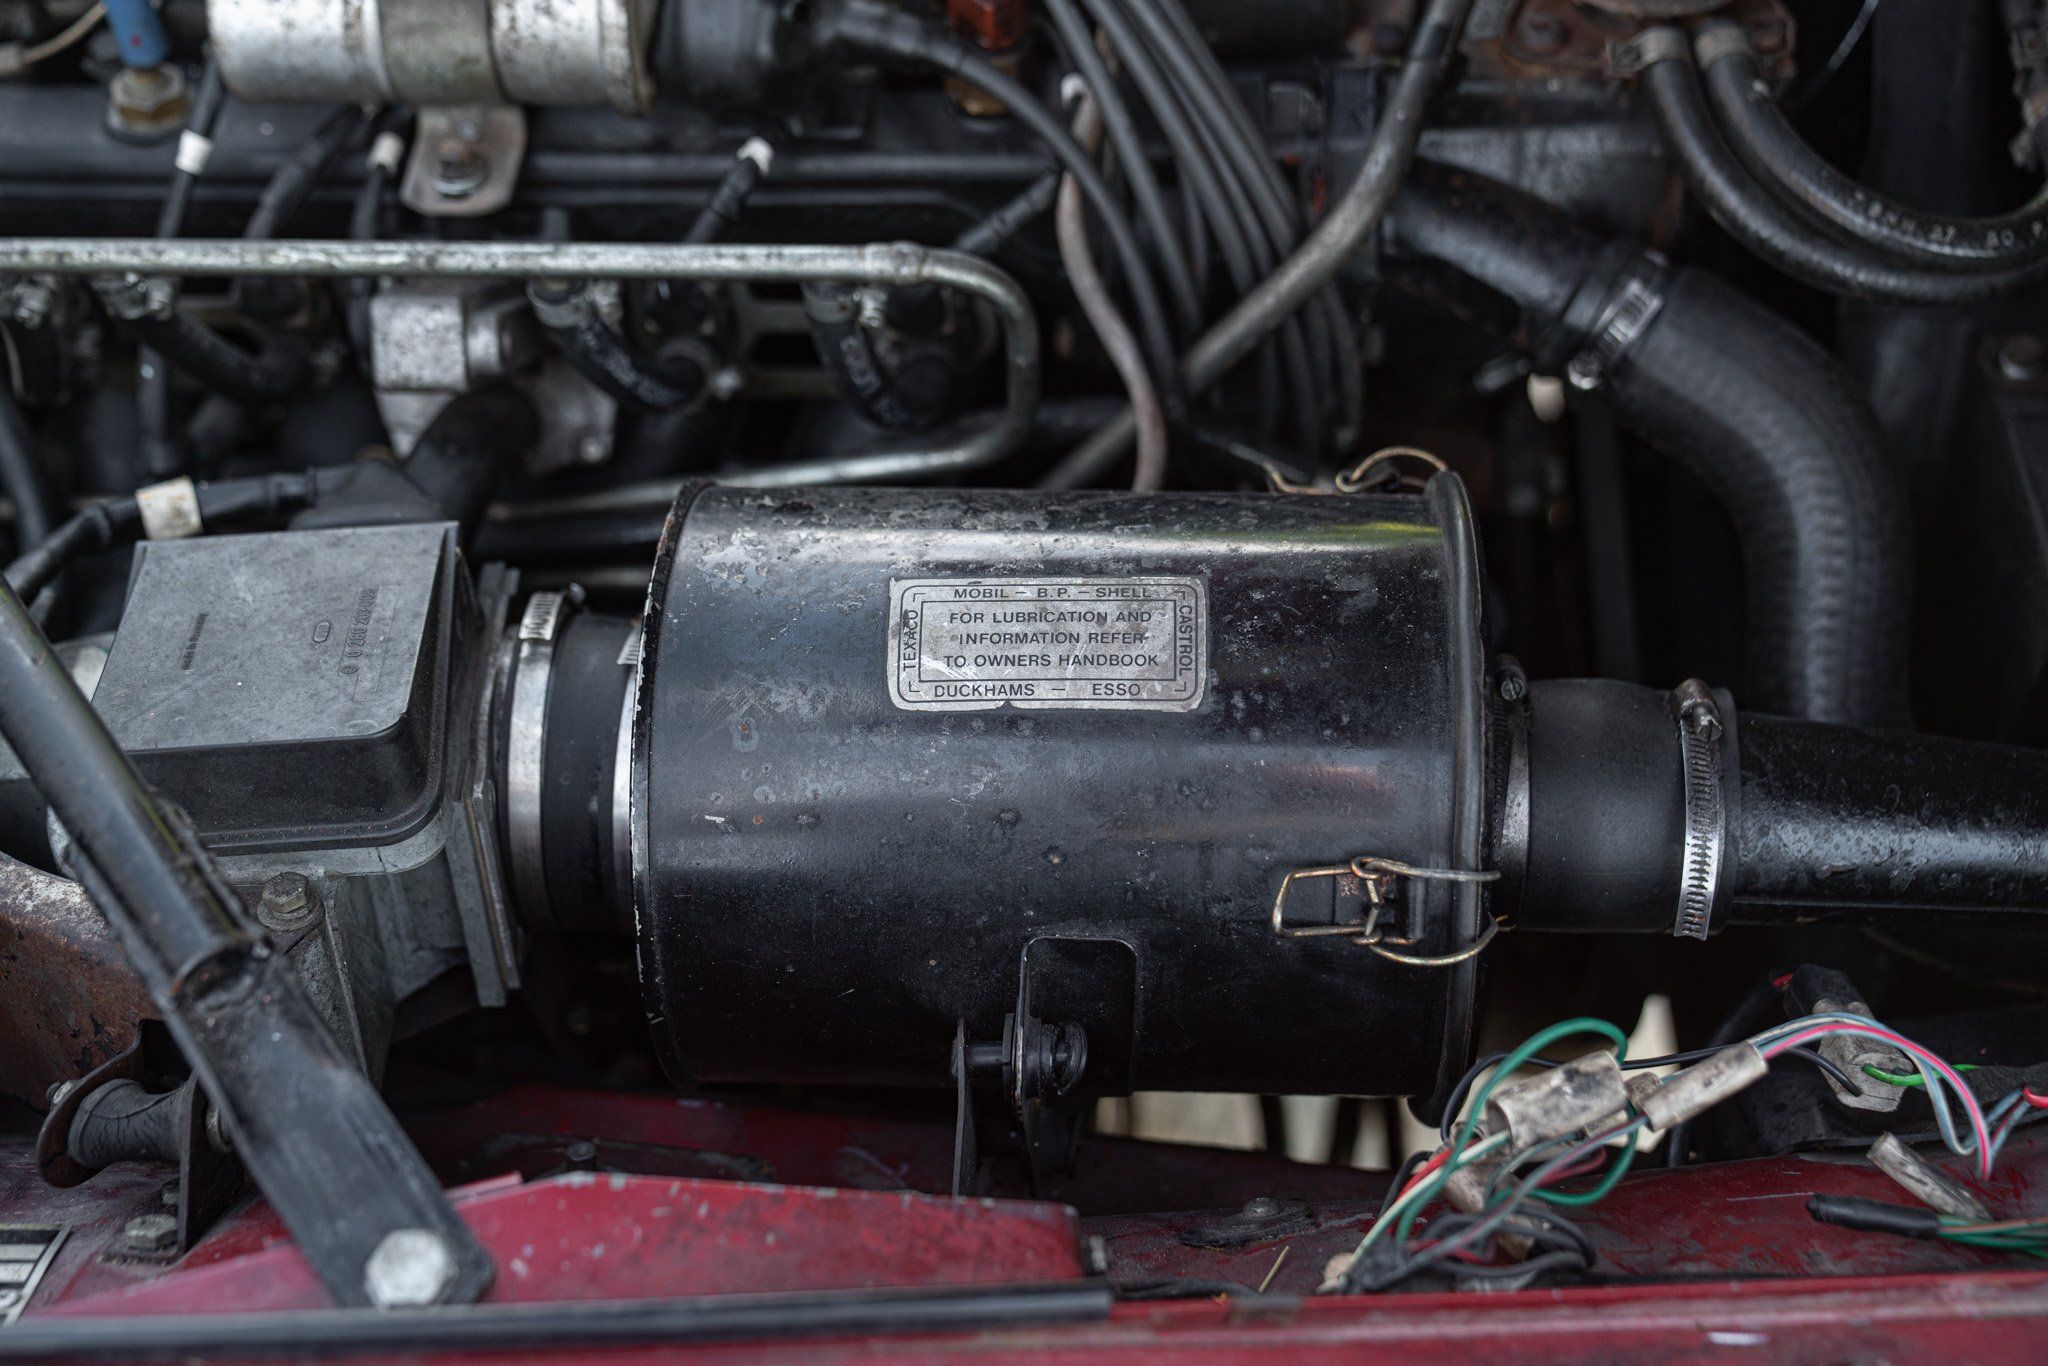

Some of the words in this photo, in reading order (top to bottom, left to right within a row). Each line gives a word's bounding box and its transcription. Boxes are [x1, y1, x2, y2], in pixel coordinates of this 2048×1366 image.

[953, 588, 1009, 599] MOBIL
[1037, 587, 1071, 598] B.P.
[1095, 587, 1152, 598] SHELL
[949, 612, 985, 624] FOR
[992, 611, 1108, 624] LUBRICATION
[1115, 611, 1152, 622] AND
[903, 609, 919, 671] TEXACO
[959, 632, 1080, 645] INFORMATION
[1088, 632, 1143, 644] REFER
[1178, 604, 1193, 676] CASTROL
[943, 655, 967, 668] TO
[973, 654, 1051, 667] OWNERS
[1058, 654, 1159, 667] HANDBOOK
[933, 683, 1035, 698] DUCKHAMS
[1092, 683, 1141, 696] ESSO
